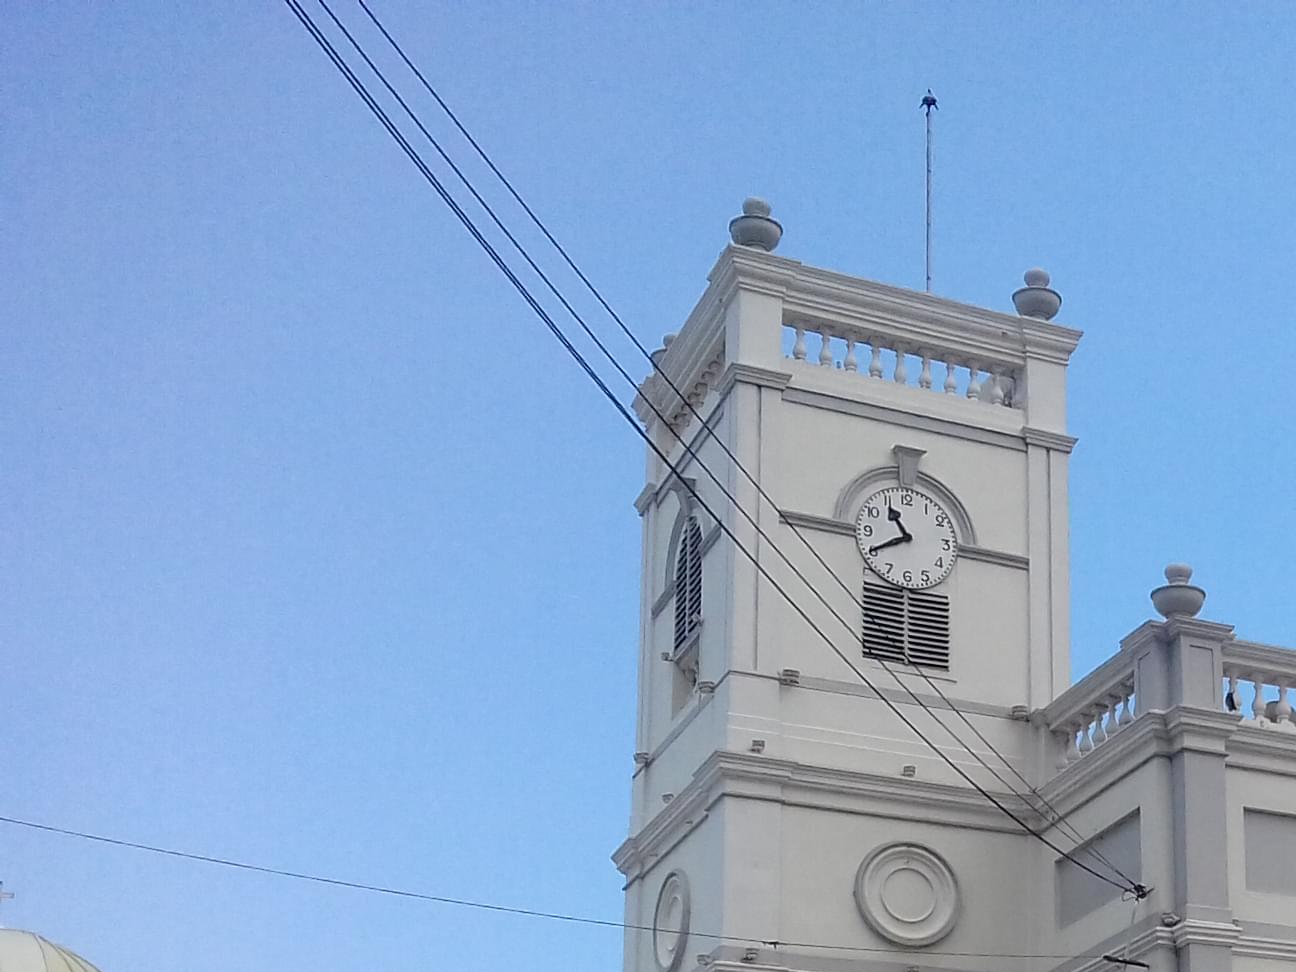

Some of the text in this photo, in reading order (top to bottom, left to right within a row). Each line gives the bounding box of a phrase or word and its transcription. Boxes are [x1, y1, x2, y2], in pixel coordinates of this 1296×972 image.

[884, 495, 891, 506] 11
[901, 493, 914, 507] 12
[867, 506, 880, 519] 10
[924, 503, 928, 515] 1
[935, 514, 945, 528] 2
[863, 524, 873, 537] 9
[941, 538, 951, 552] 3
[884, 562, 894, 575] 7
[934, 556, 943, 569] 4
[902, 570, 912, 583] 6
[920, 570, 930, 583] 5
